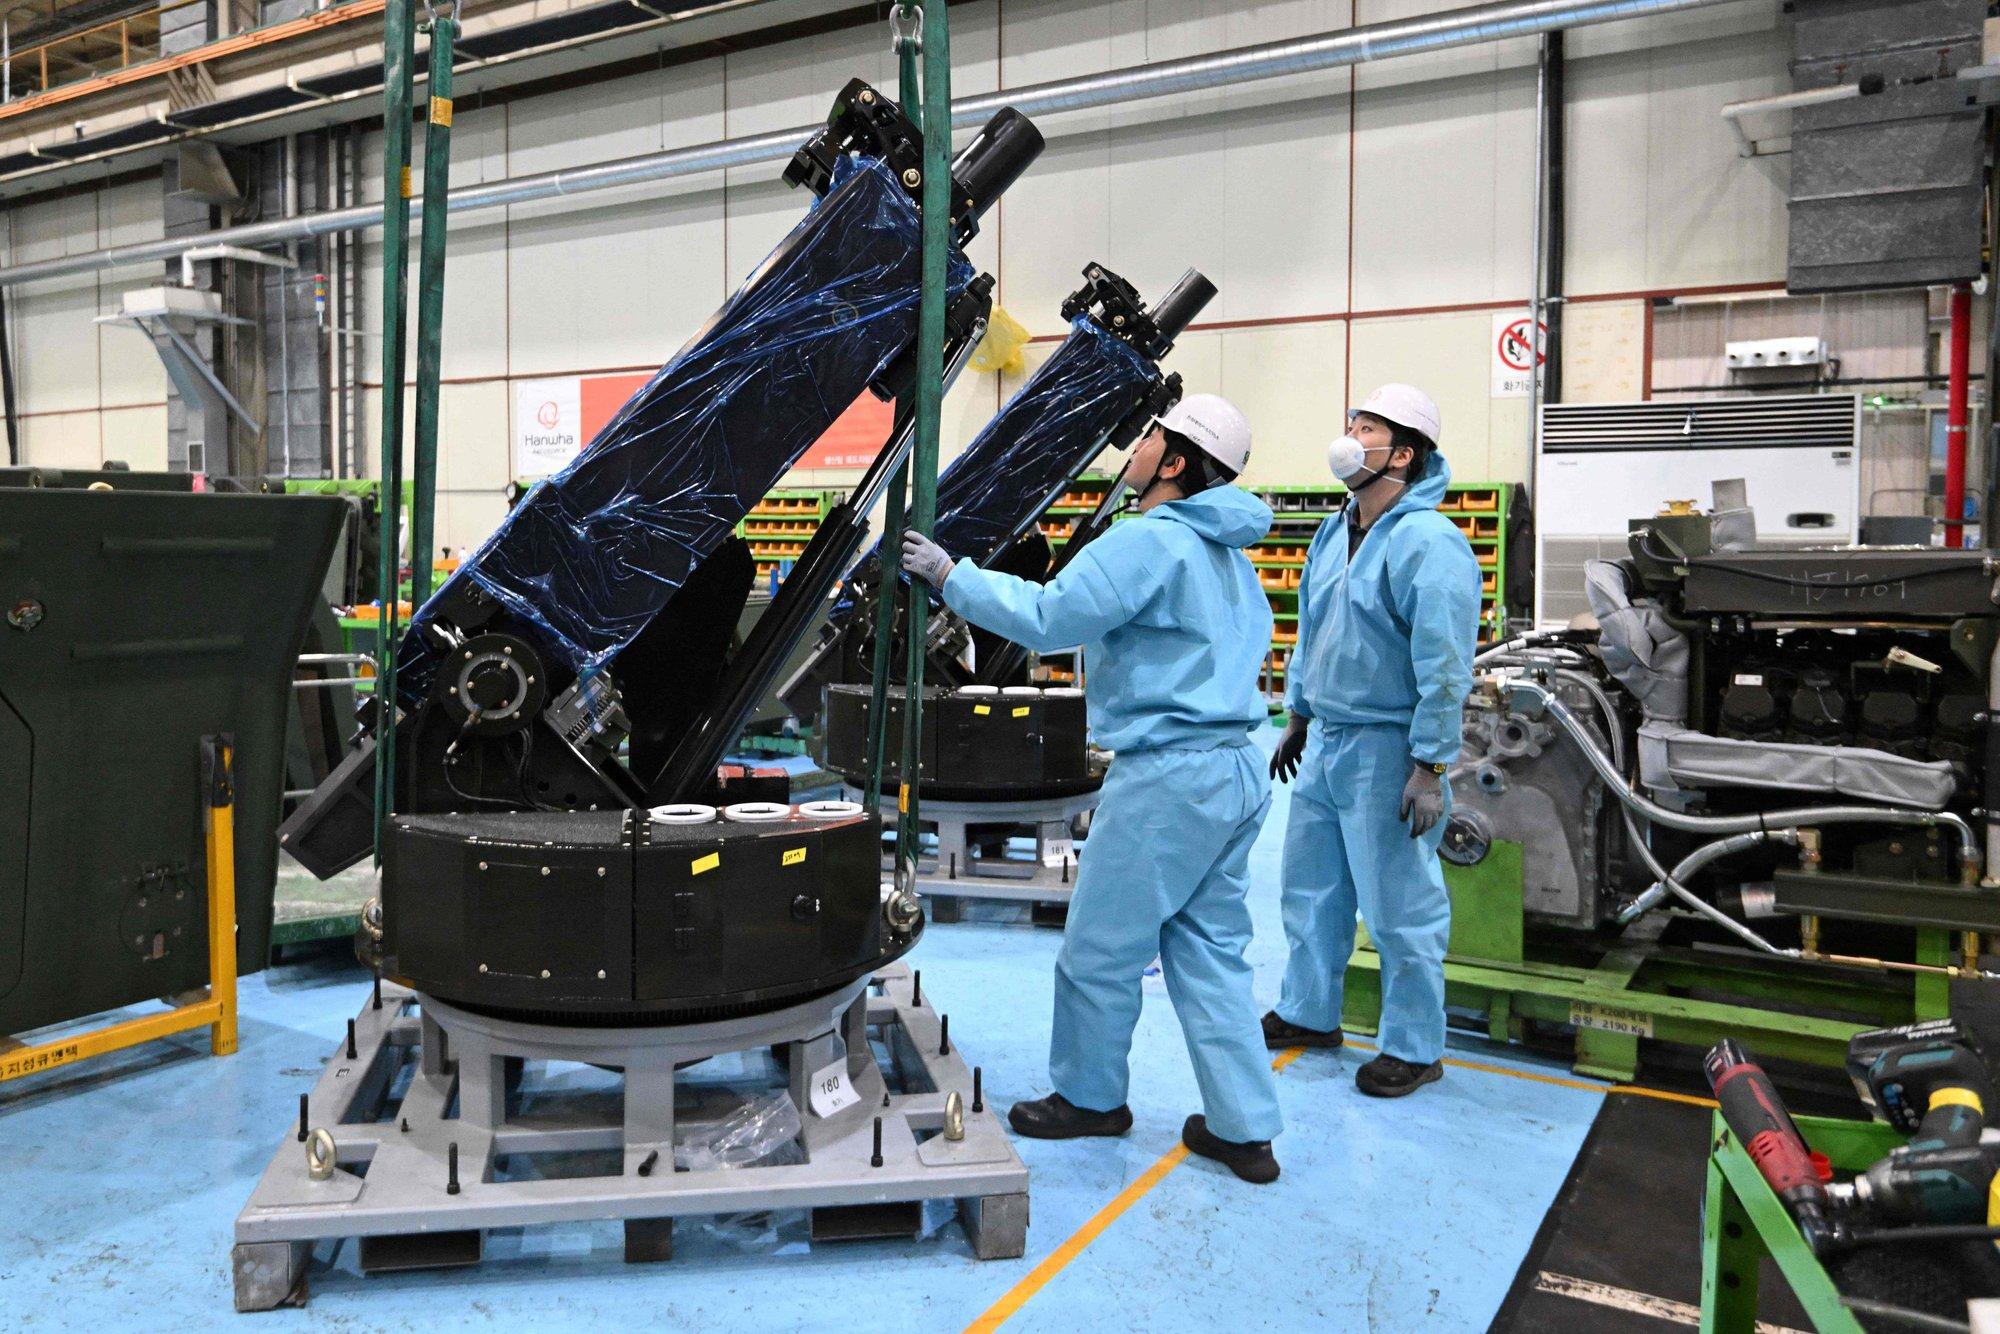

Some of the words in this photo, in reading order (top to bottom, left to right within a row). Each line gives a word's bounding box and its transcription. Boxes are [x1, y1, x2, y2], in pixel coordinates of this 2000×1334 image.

[525, 433, 573, 446] Hanwha
[1052, 846, 1064, 855] 181
[1602, 1019, 1627, 1032] 2190
[821, 1075, 839, 1095] 180
